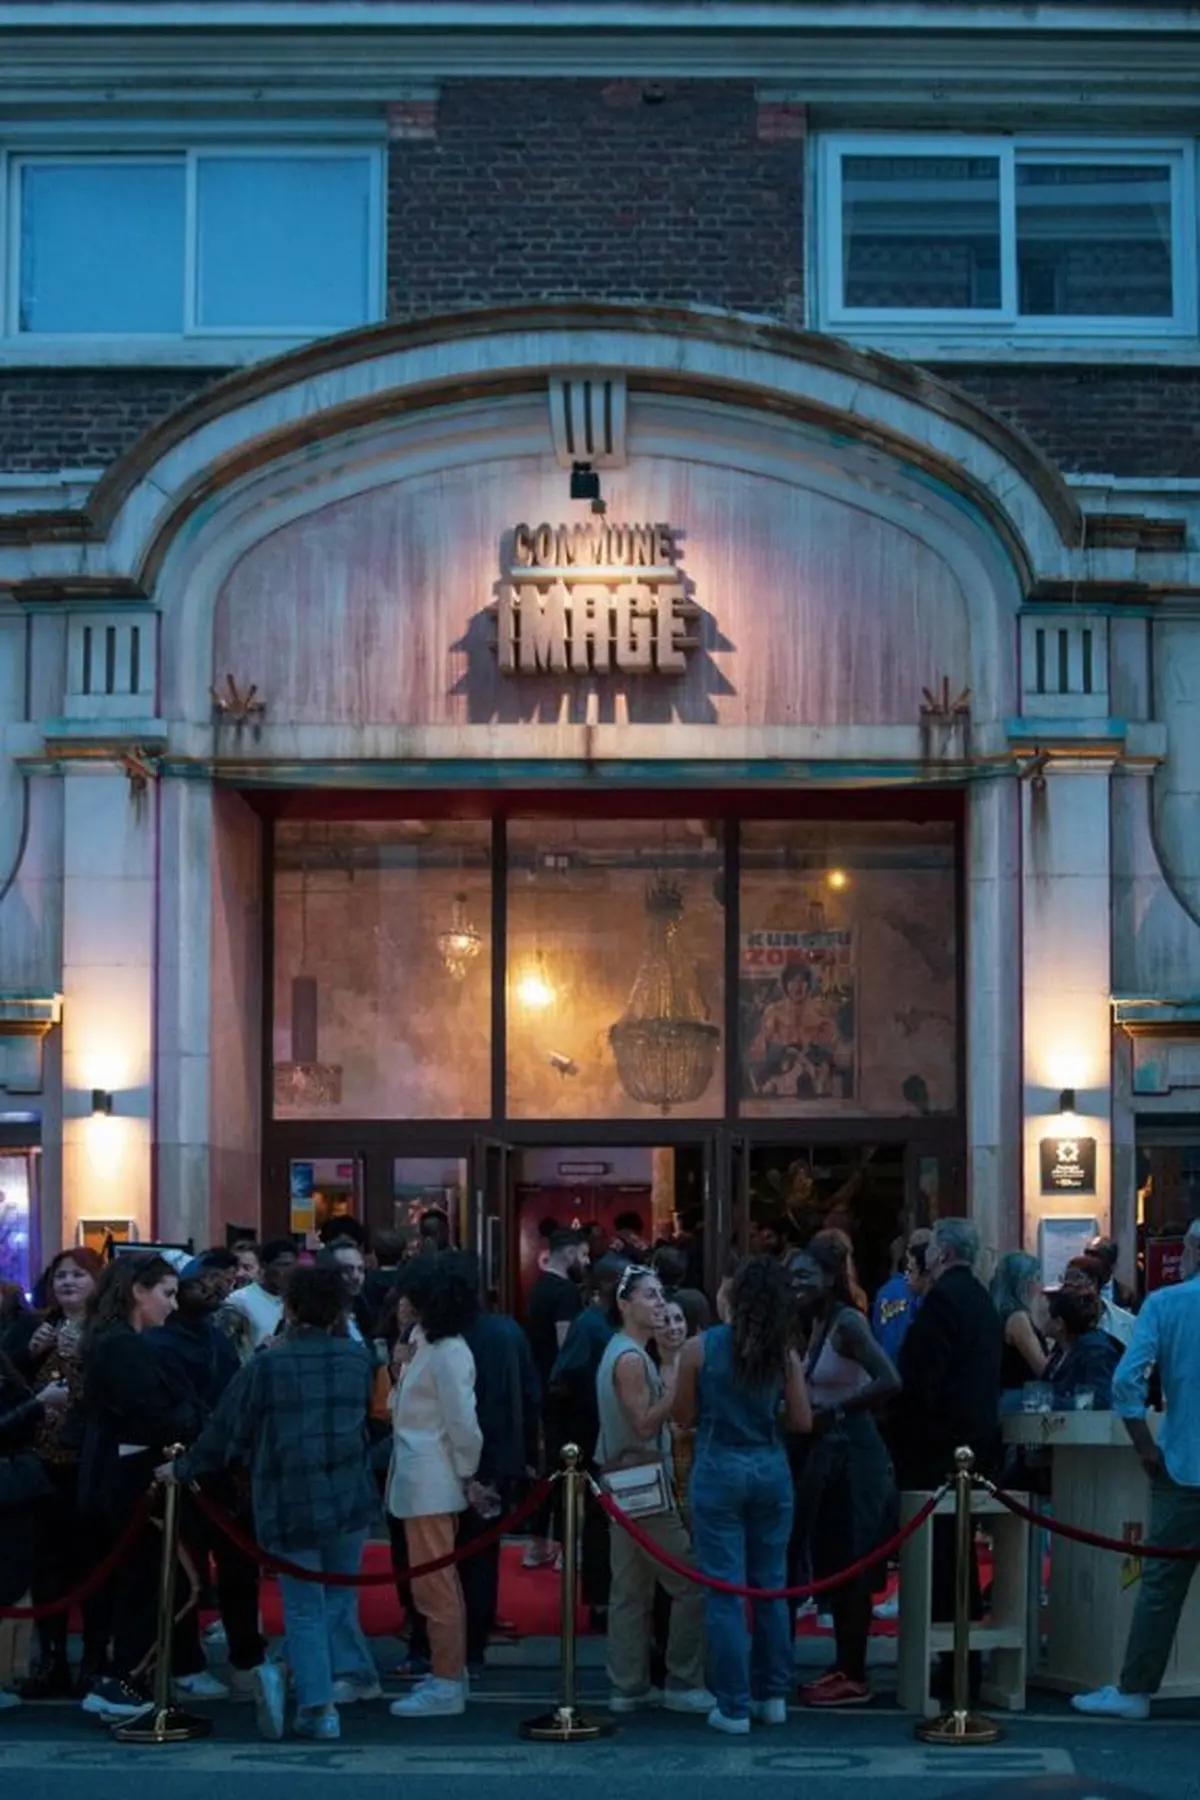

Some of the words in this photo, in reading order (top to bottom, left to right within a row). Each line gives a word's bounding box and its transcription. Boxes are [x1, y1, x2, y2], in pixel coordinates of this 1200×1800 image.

[514, 522, 674, 566] COMMUNE
[499, 579, 686, 676] IMAGE
[747, 933, 818, 946] KUN
